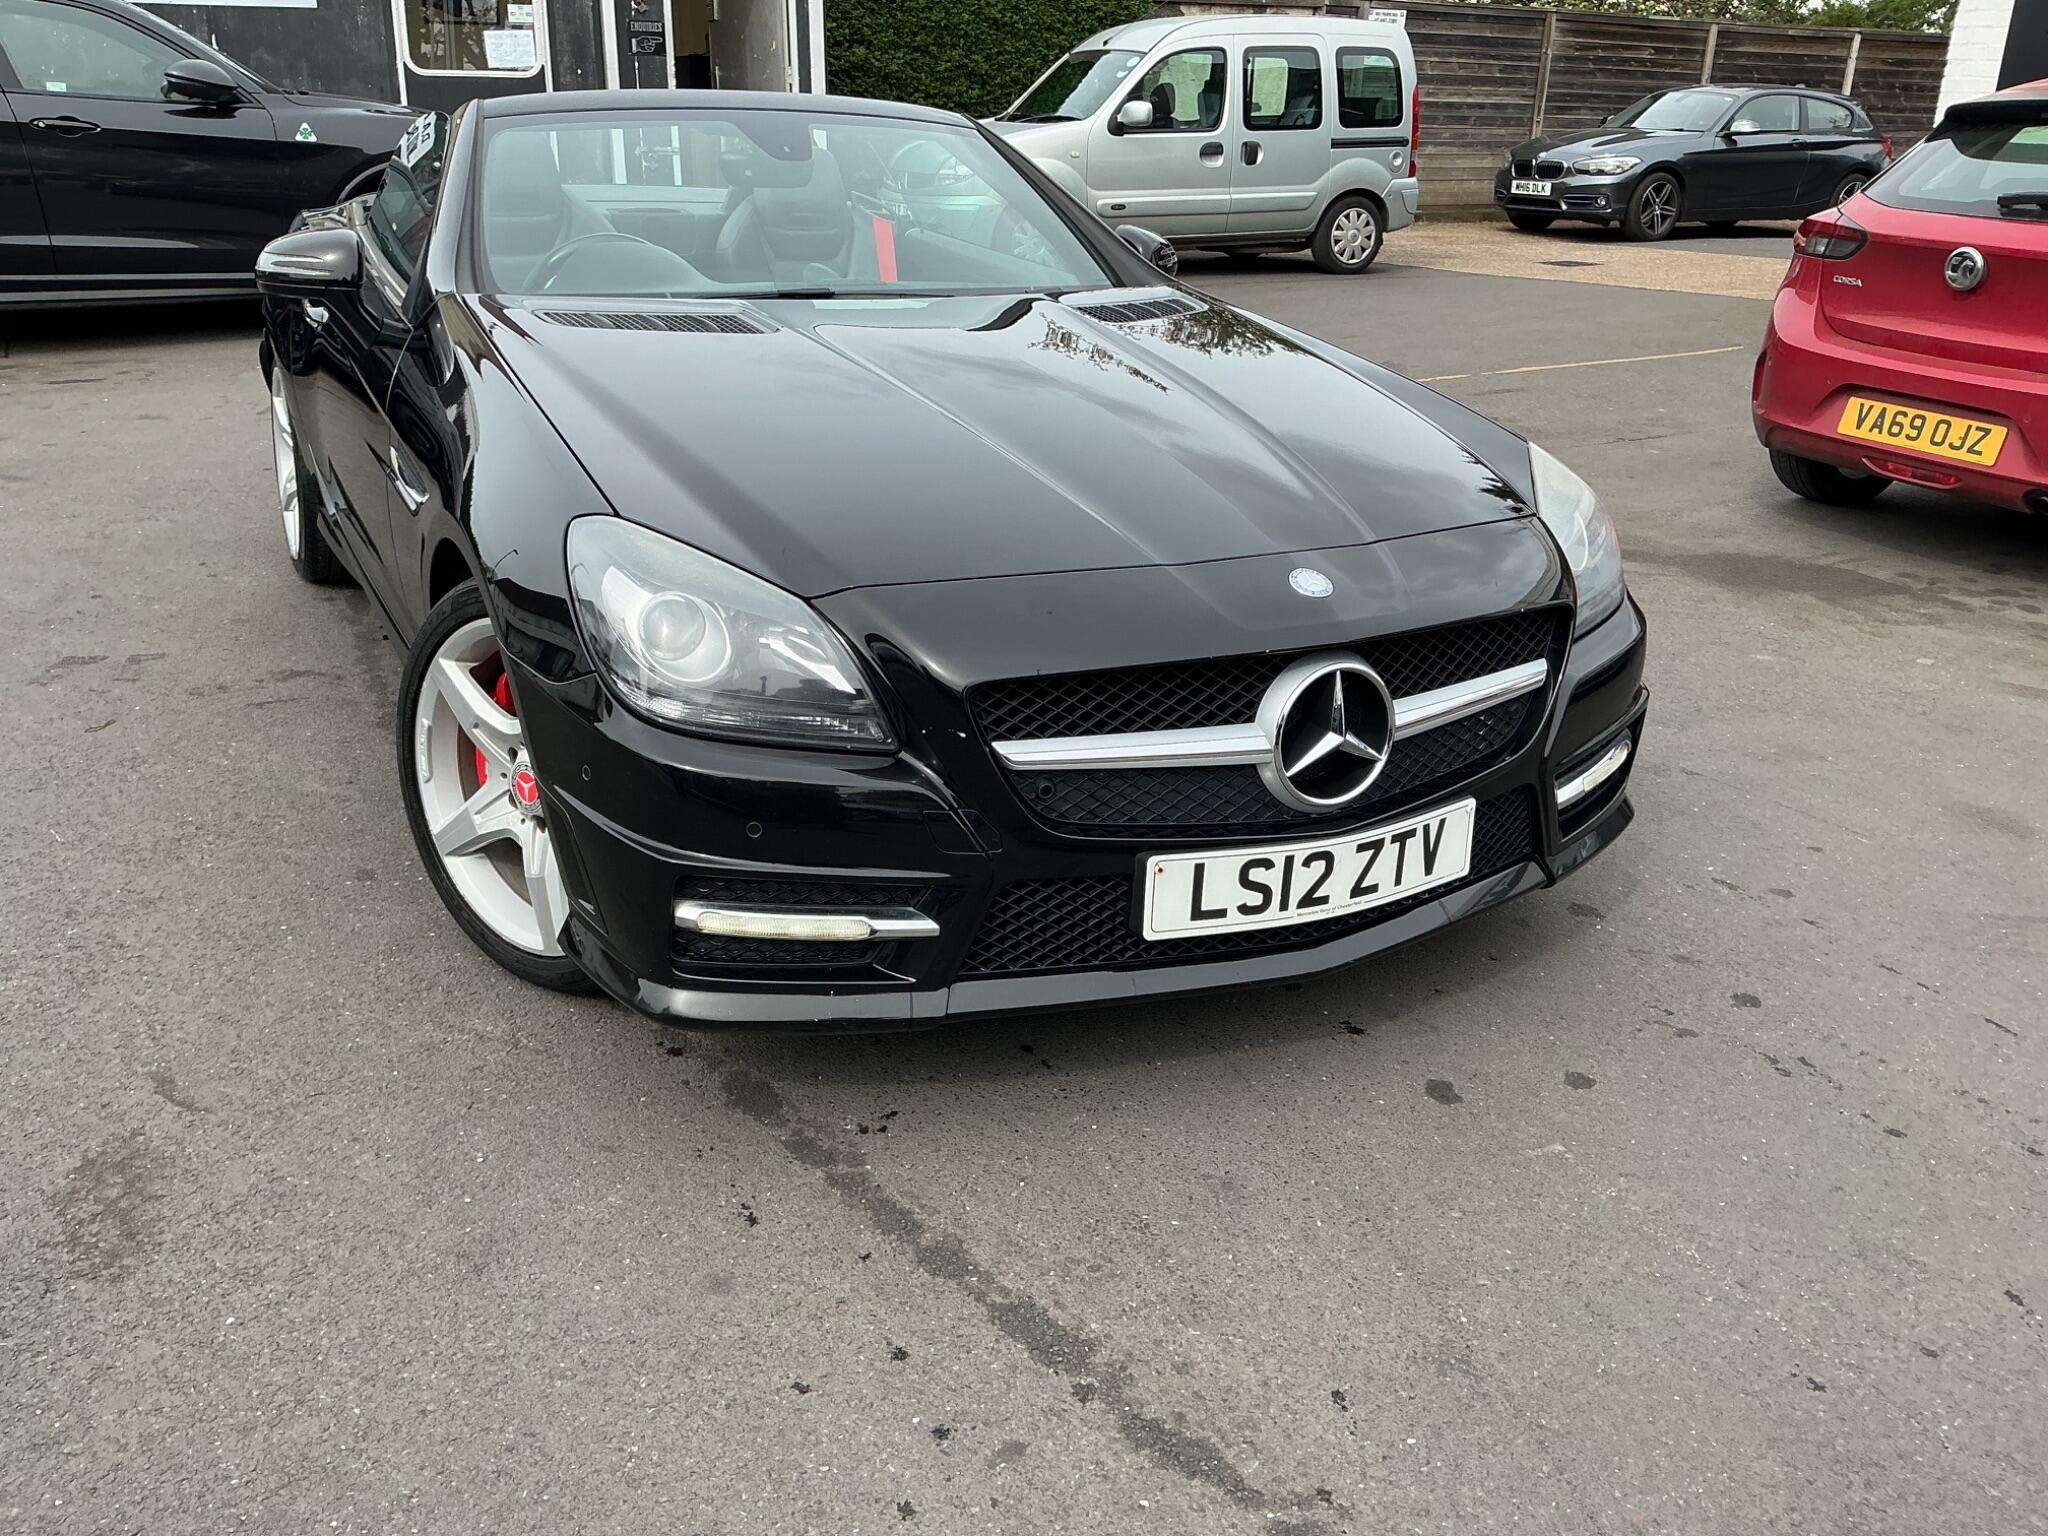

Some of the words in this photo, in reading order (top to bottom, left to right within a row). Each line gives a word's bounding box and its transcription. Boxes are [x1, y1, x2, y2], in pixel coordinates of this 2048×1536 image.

[630, 21, 662, 32] ENQUIRIES
[1532, 183, 1546, 193] DLK
[1833, 275, 1863, 287] CORSA
[1855, 402, 1927, 442] VA69
[1929, 418, 1992, 457] OJZ
[1190, 850, 1335, 922] LS12
[1350, 817, 1447, 900] ZTV
